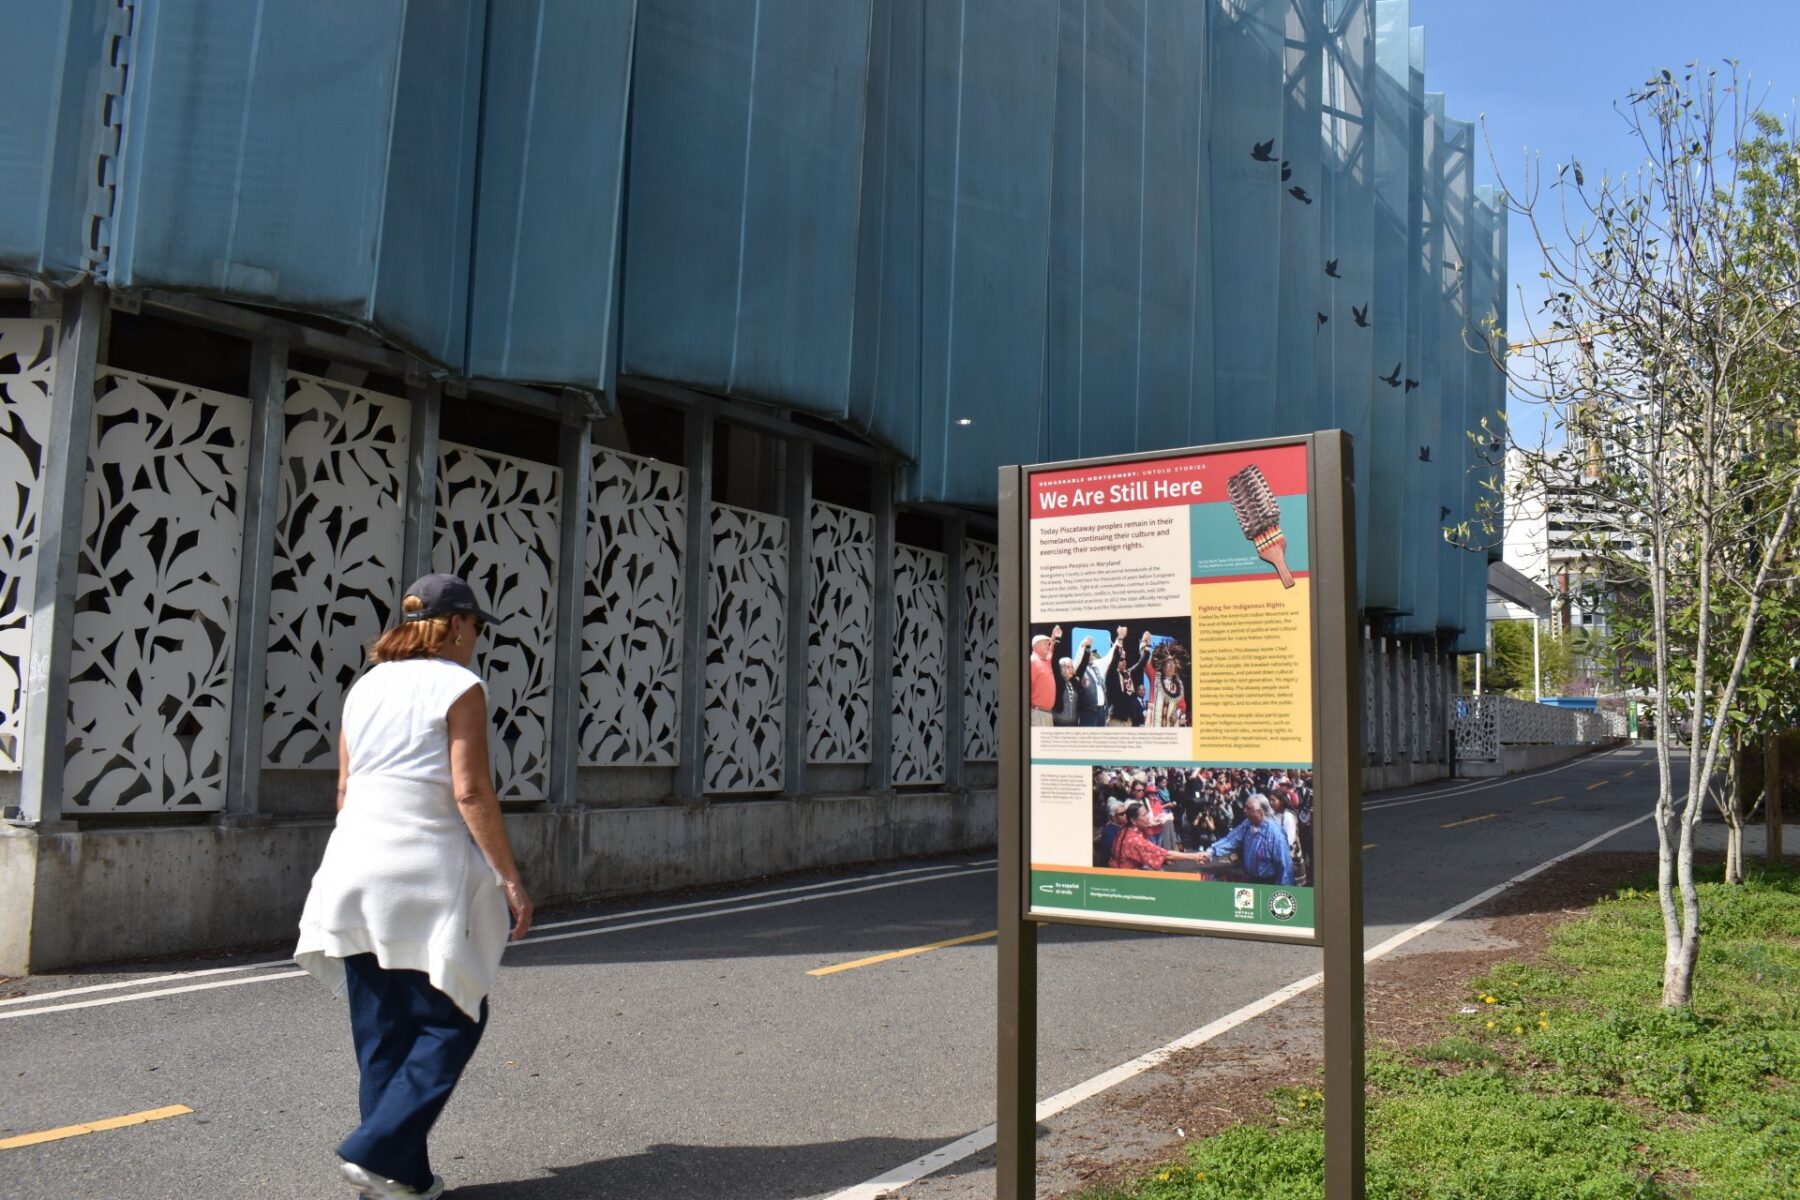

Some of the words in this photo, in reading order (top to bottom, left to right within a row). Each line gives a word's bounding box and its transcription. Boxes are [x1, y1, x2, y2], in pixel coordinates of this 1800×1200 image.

[1039, 478, 1084, 486] REMARKABLE
[1039, 492, 1068, 509] We
[1072, 489, 1104, 506] Are
[1110, 481, 1148, 503] Still
[1154, 480, 1202, 498] Here
[1060, 525, 1095, 533] Piscataway
[1097, 522, 1122, 531] peoples
[1040, 537, 1077, 545] homelands,
[1079, 534, 1113, 542] continuing
[1040, 548, 1071, 556] exercising
[1090, 544, 1120, 552] sovereign
[1123, 542, 1143, 550] rights.
[1233, 603, 1265, 611] Indigenous
